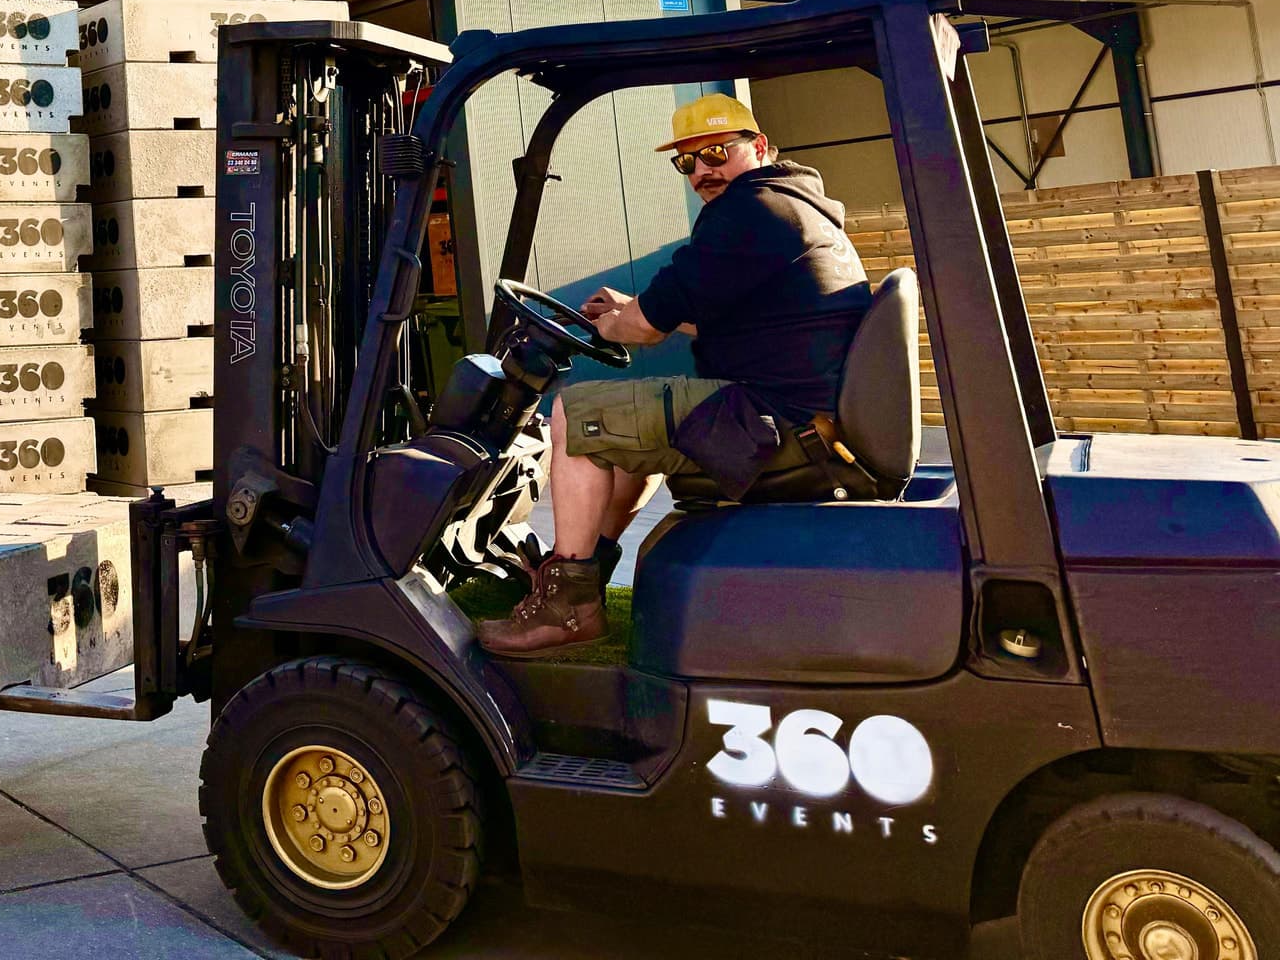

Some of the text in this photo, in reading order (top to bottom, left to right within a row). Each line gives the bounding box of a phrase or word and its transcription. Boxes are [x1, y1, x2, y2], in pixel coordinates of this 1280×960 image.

[79, 17, 108, 50] 360
[230, 202, 256, 365] TOYOTA
[0, 396, 64, 406] EVENTS
[47, 560, 119, 637] 360
[706, 698, 934, 805] 360
[710, 797, 938, 844] EVENTS
